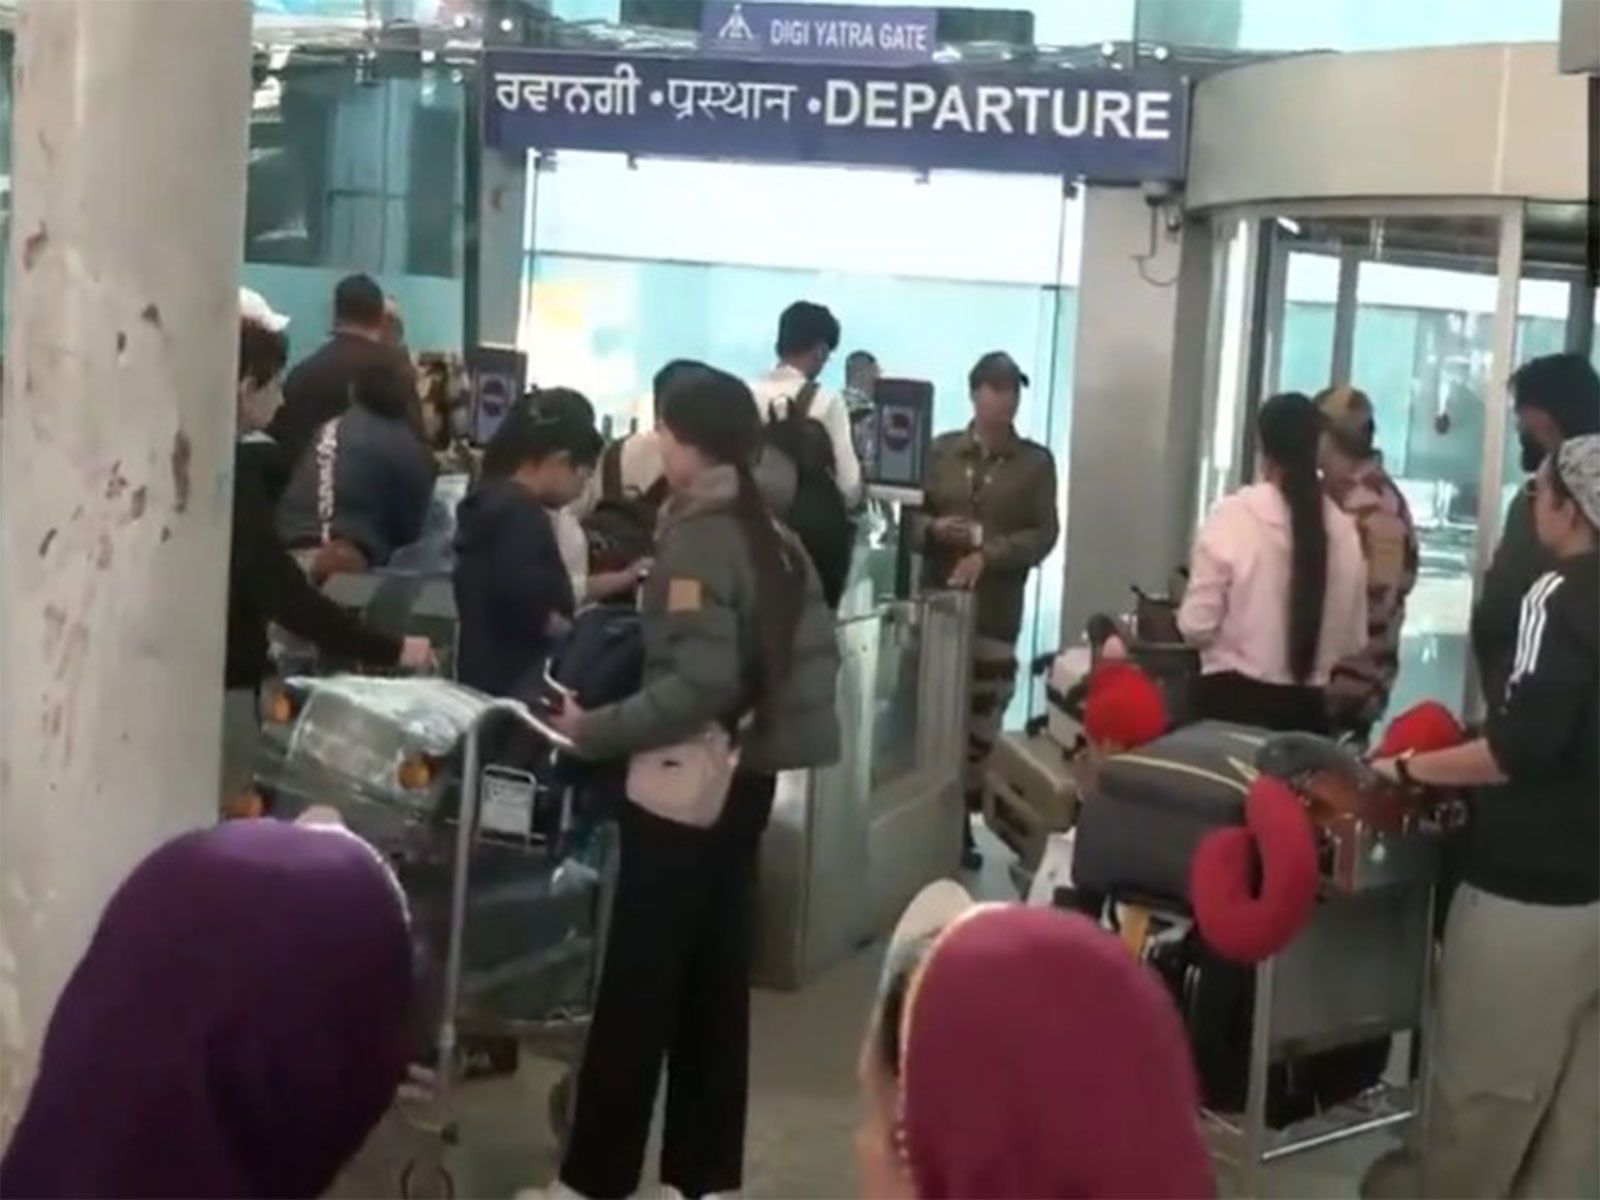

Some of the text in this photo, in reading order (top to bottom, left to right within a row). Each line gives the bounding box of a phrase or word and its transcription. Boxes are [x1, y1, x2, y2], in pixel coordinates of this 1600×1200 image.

[770, 20, 928, 50] DIGI YATRA GATE
[494, 62, 642, 115] ਰਵਾਨਗੀ
[667, 78, 799, 121] प्रस्थान
[825, 79, 1172, 139] DEPARTURE
